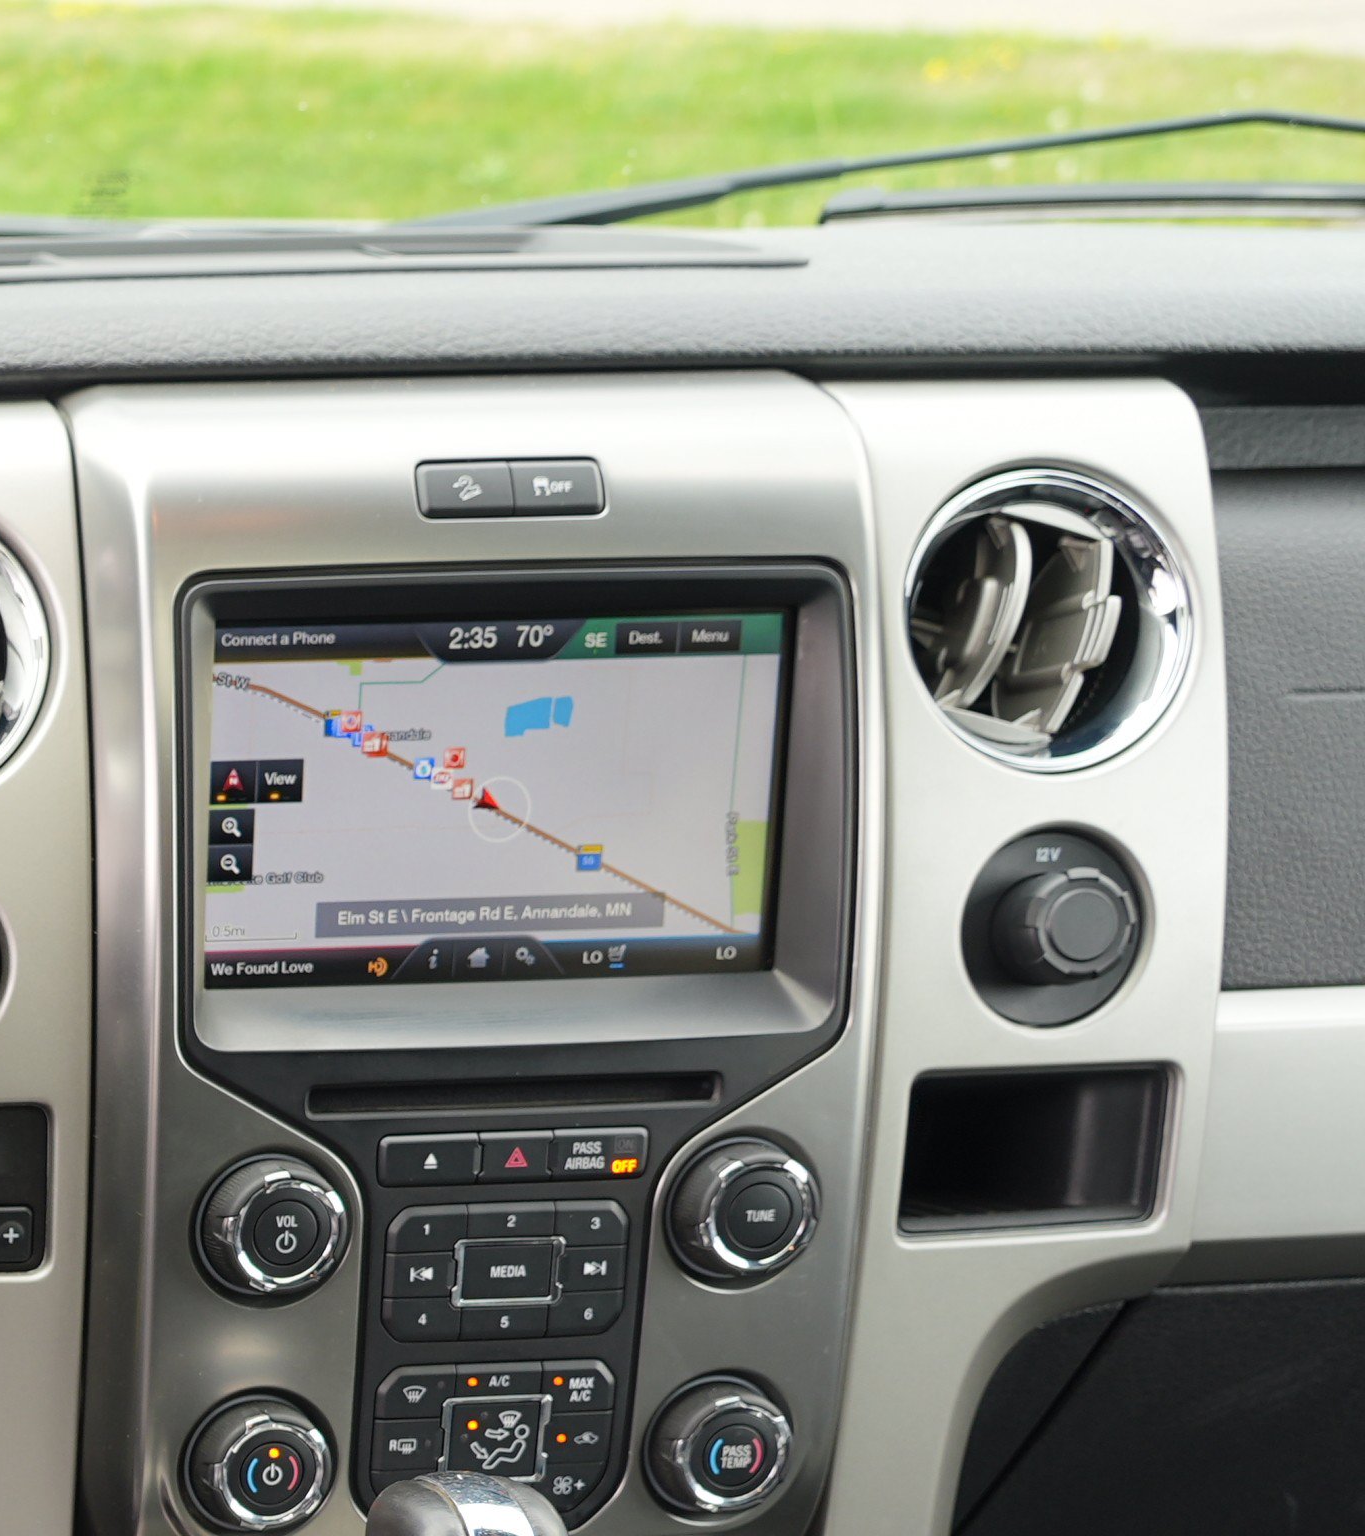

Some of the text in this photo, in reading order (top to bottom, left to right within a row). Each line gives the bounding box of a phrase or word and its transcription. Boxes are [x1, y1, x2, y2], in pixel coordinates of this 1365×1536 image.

[550, 480, 573, 494] OFF
[221, 631, 336, 648] Connect a Phone
[448, 626, 498, 650] 2:35
[585, 632, 608, 649] SE
[628, 630, 662, 645] Dest.
[691, 628, 730, 643] Menu
[265, 772, 296, 785] View
[1036, 847, 1061, 862] 12V
[266, 872, 292, 884] Golf
[294, 872, 324, 884] Club
[337, 910, 365, 925] Elm
[368, 909, 384, 924] St
[387, 909, 397, 924] E
[412, 907, 475, 925] Frontage
[479, 905, 500, 920] Rd
[504, 905, 517, 922] E,
[521, 902, 601, 919] Annandale,
[605, 901, 632, 916] MN
[582, 951, 603, 964] LO
[716, 946, 737, 960] LO
[211, 960, 314, 976] We Found Love
[572, 1142, 602, 1155] PASS
[564, 1158, 605, 1171] AIRBAG
[612, 1159, 637, 1174] OFF
[275, 1215, 298, 1228] VOL
[507, 1215, 517, 1228] 2
[745, 1209, 777, 1222] TUNE
[423, 1224, 431, 1235] 1
[590, 1217, 601, 1230] 3
[490, 1265, 526, 1278] MEDIA
[417, 1313, 427, 1325] 4
[583, 1307, 594, 1320] 6
[499, 1316, 510, 1329] 5
[488, 1375, 511, 1387] A/C
[569, 1377, 595, 1390] MAX
[570, 1390, 592, 1403] A/C
[721, 1446, 752, 1457] PASS
[720, 1456, 752, 1469] TEMP
